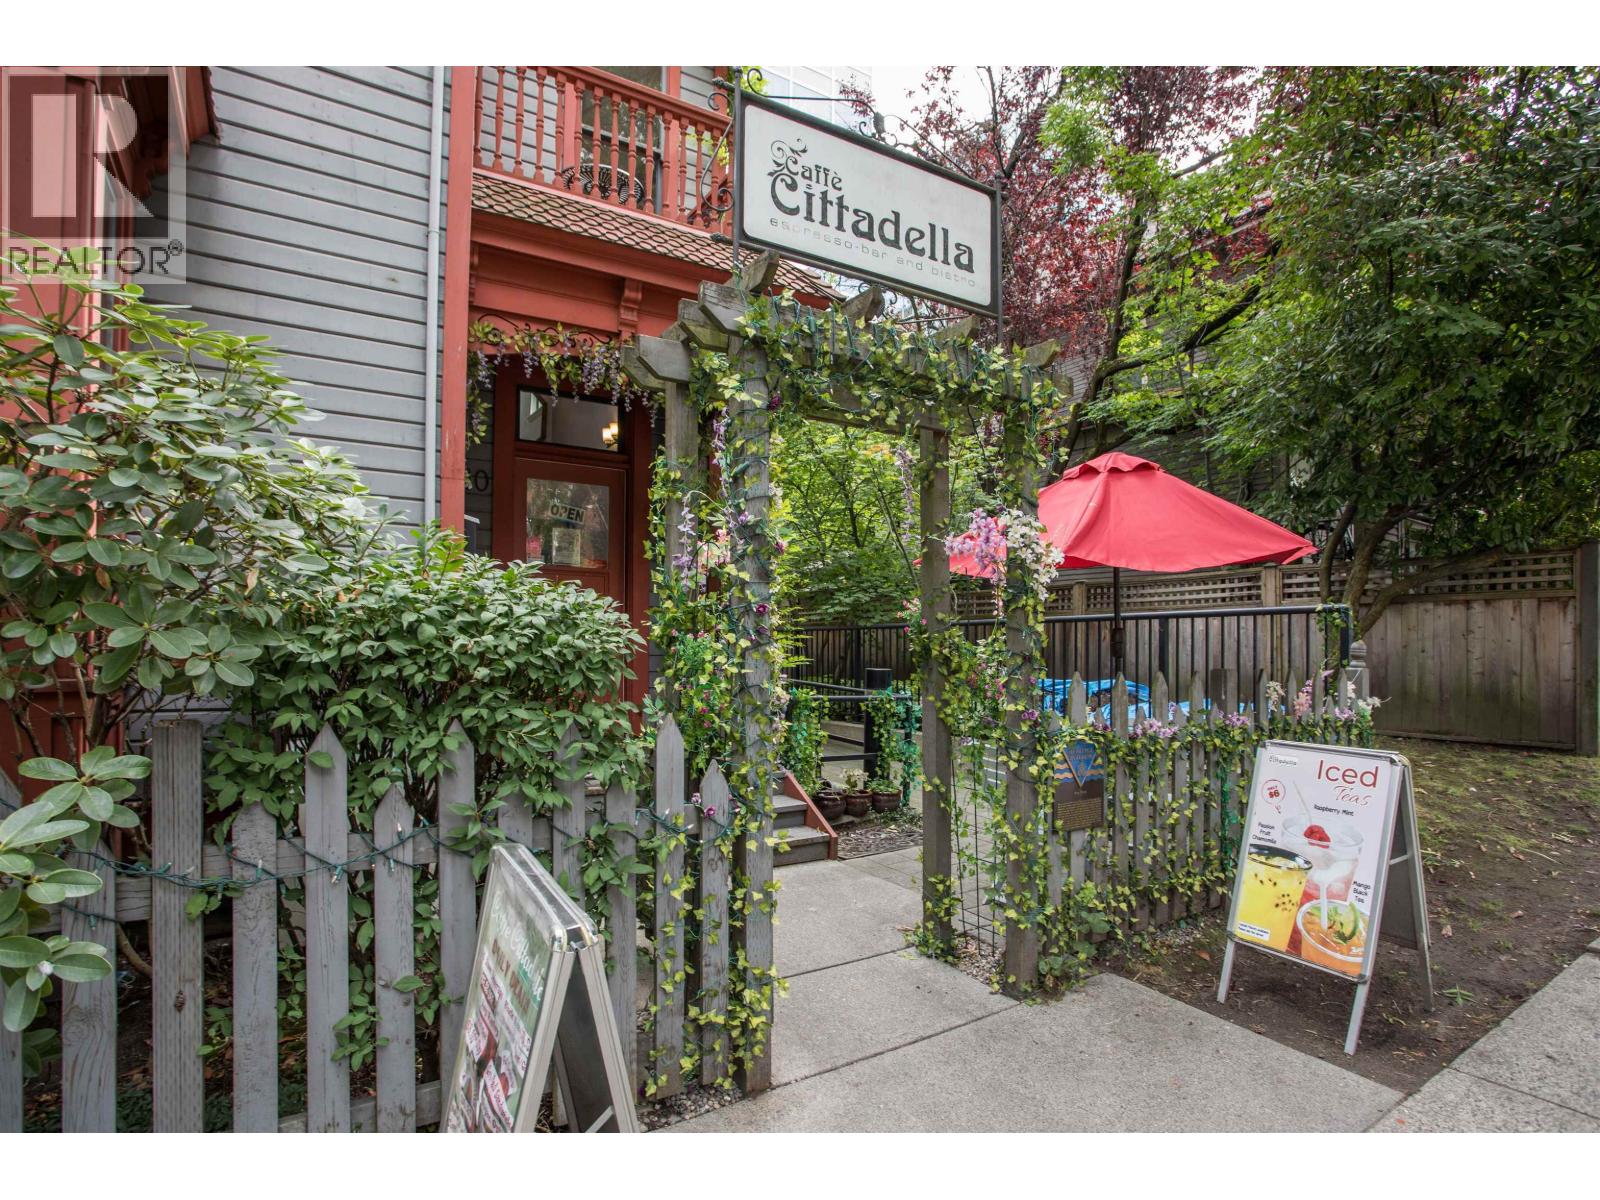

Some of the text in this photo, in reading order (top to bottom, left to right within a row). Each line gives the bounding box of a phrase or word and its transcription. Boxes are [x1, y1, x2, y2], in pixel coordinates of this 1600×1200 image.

[771, 173, 975, 274] Cittadella
[896, 255, 923, 271] and
[550, 504, 585, 523] OPEN
[1317, 760, 1379, 788] Iced
[1268, 789, 1280, 798] $6
[1334, 785, 1373, 807] Teas
[1314, 804, 1354, 816] Raspberry Mint
